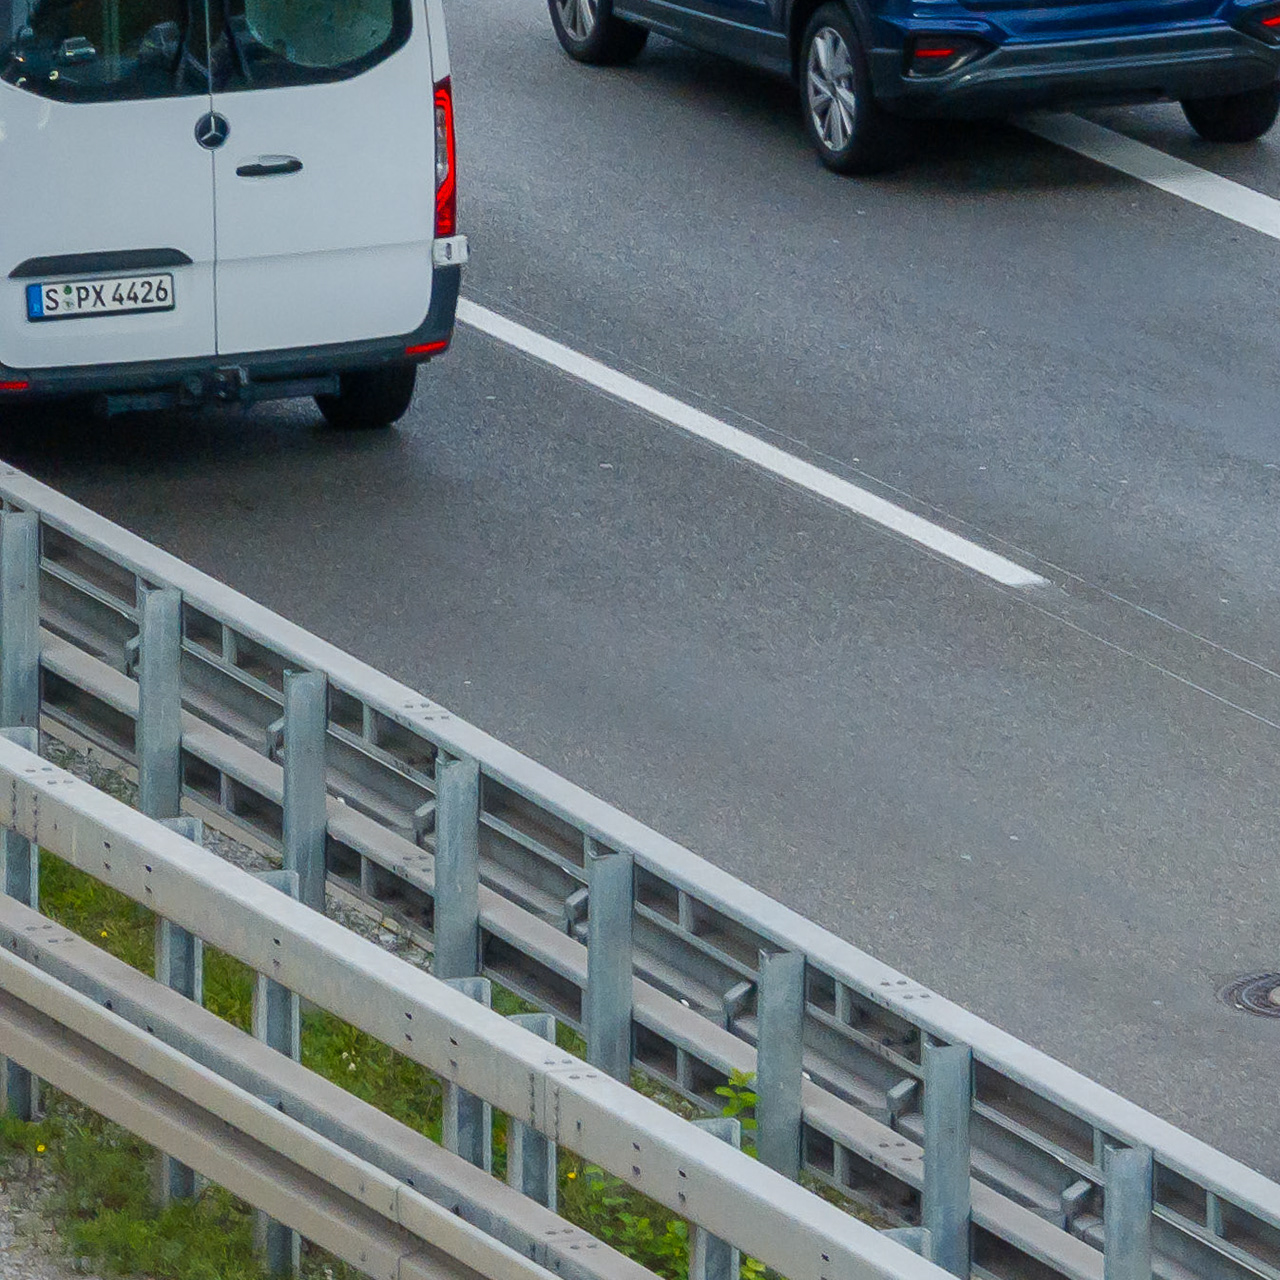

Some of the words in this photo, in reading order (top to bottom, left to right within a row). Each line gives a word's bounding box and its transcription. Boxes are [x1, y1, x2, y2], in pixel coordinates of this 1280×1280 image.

[45, 289, 59, 311] S
[76, 284, 106, 308] PX
[112, 279, 168, 305] 4426
